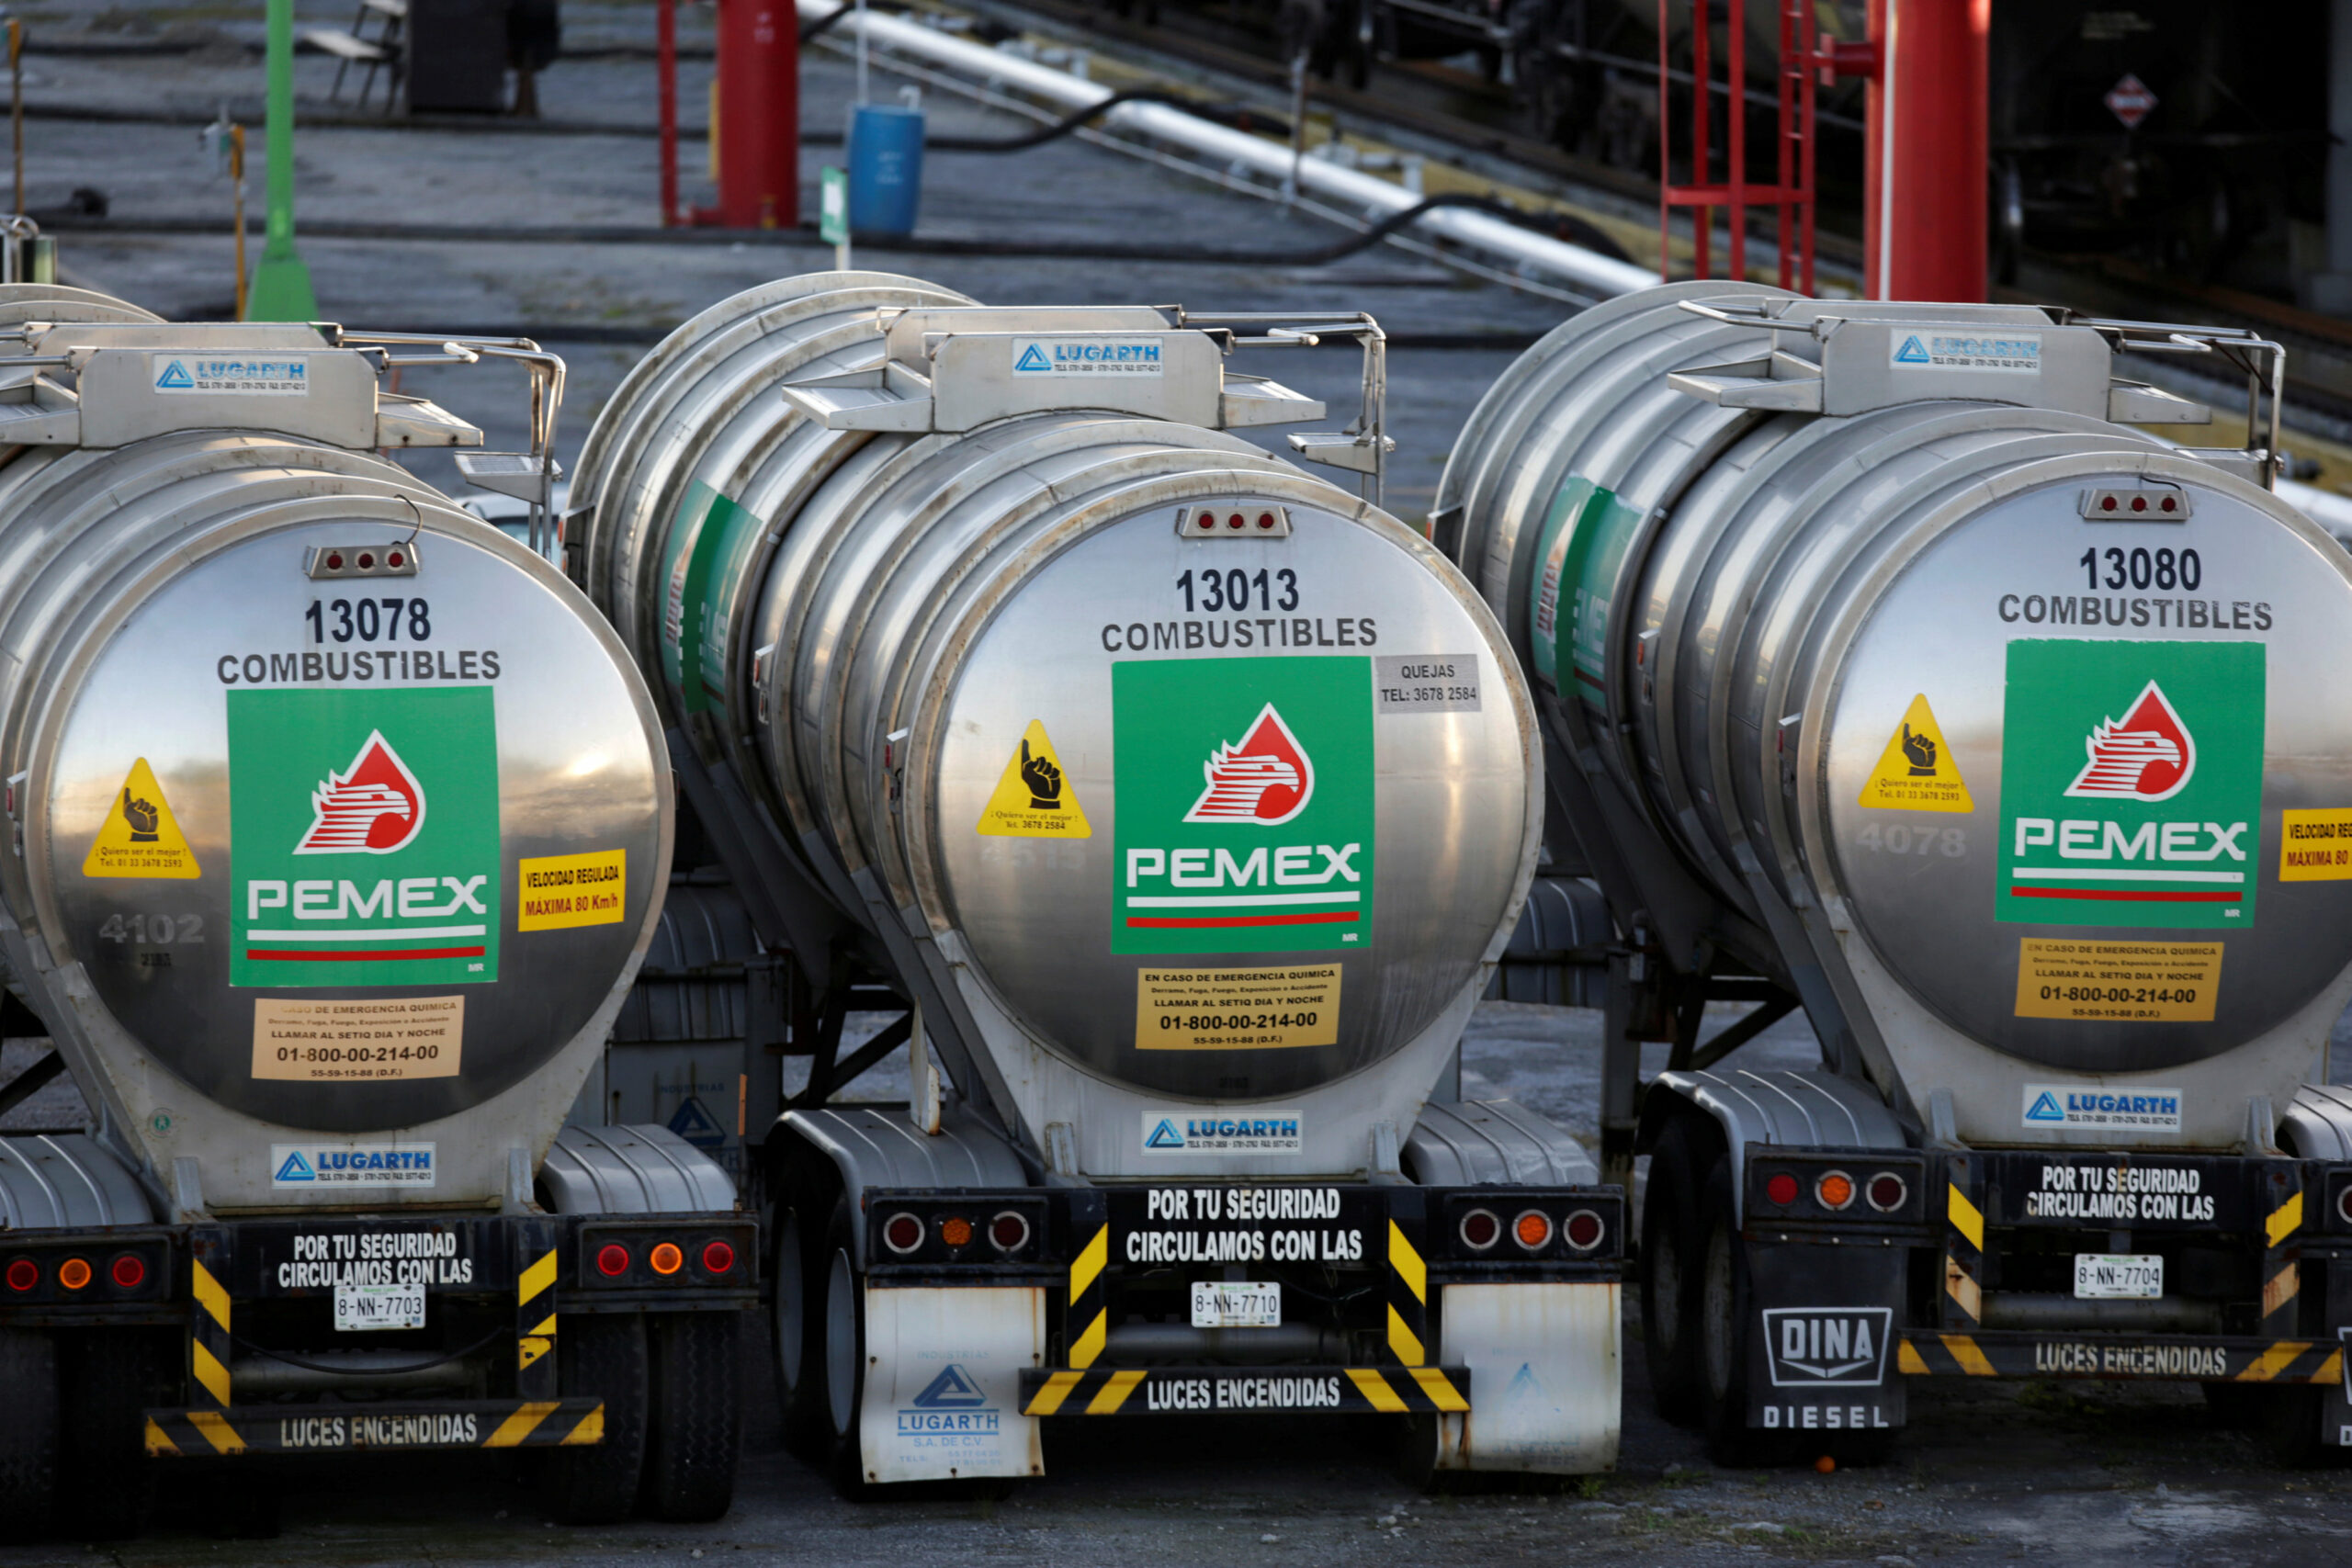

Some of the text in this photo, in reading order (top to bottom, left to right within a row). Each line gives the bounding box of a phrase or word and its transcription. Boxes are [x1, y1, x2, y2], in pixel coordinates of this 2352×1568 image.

[1055, 344, 1159, 362] LUGARTH
[1932, 337, 2037, 357] LUGARTH
[197, 361, 305, 379] LUGARTH
[2080, 547, 2201, 591] 13080
[1176, 568, 1299, 612] 13013
[305, 598, 431, 643] 13078
[1998, 594, 2273, 630] COMBUSTIBLES
[1102, 618, 1377, 652] COMBUSTIBLES
[218, 650, 501, 683] COMBUSTIBLES
[1401, 664, 1455, 679] QUEJAS
[1381, 686, 1476, 702] TEL: 3678 2584
[1023, 820, 1042, 829] 3678
[1045, 821, 1065, 829] 2584
[2289, 823, 2335, 840] VELOCIDAD
[1856, 823, 1966, 858] 4078
[2014, 818, 2247, 861] PEMEX
[1126, 842, 1361, 887] PEMEX
[2287, 847, 2348, 867] MÁXIMA 80
[526, 865, 618, 887] VELOCIDAD REGULADA
[247, 875, 486, 919] PEMEX
[526, 892, 617, 916] MÁXIMA 80 Km/h
[99, 914, 205, 944] 4102
[1342, 932, 1358, 942] MR
[2046, 944, 2075, 953] CASO
[2078, 945, 2093, 953] DE
[2096, 946, 2167, 955] EMERGENCIA
[2170, 947, 2217, 956] QUIMICA
[468, 963, 484, 972] MR
[1196, 974, 1211, 982] DE
[1214, 972, 1285, 982] EMERGENCIA
[1288, 970, 1335, 979] QUIMICA
[2036, 970, 2080, 978] LLAMAR
[2083, 971, 2096, 979] AL
[2099, 972, 2132, 980] SETIQ
[2135, 972, 2153, 980] DIA
[1154, 999, 1198, 1008] LLAMAR
[1219, 998, 1251, 1007] SETIQ
[1255, 998, 1272, 1006] DIA
[1286, 996, 1324, 1004] NOCHE
[2040, 986, 2196, 1003] 01-800-00-214-00
[315, 1006, 329, 1014] DE
[333, 1005, 406, 1014] EMERGENCIA
[409, 1002, 457, 1012] QUIMICA
[1160, 1012, 1317, 1030] 01-800-00-214-00
[271, 1028, 446, 1040] LLAMAR AL SETIQ DIA Y NOCHE
[1193, 1035, 1282, 1044] 55-59-15-88 (D.F.)
[277, 1044, 438, 1062] 01-800-00-214-00
[376, 1068, 402, 1077] (D.F.)
[2068, 1094, 2177, 1114] LUGARTH
[1187, 1119, 1297, 1137] LUGARTH
[318, 1152, 430, 1170] LUGARTH
[2042, 1166, 2199, 1193] POR TU SEGURIDAD
[1148, 1189, 1340, 1220] POR TU SEGURIDAD
[2027, 1191, 2215, 1220] CIRCULAMOS CON LAS
[294, 1233, 457, 1260] POR TU SEGURIDAD
[1126, 1229, 1363, 1262] CIRCULAMOS CON LAS
[278, 1258, 472, 1288] CIRCULAMOS CON LAS
[2078, 1267, 2160, 1285] 8-NN-7704
[338, 1297, 422, 1316] 8-NN-7703
[1195, 1294, 1276, 1314] 8-NN-7710
[1782, 1319, 1874, 1359] DINA
[2035, 1342, 2226, 1375] LUCES ENCENDIDAS
[1148, 1377, 1340, 1411] LUCES ENCENDIDAS
[898, 1415, 999, 1430] LUGARTH
[1764, 1405, 1889, 1428] DIESEL
[280, 1413, 478, 1447] LUCES ENCENDIDAS
[942, 1437, 958, 1447] DE
